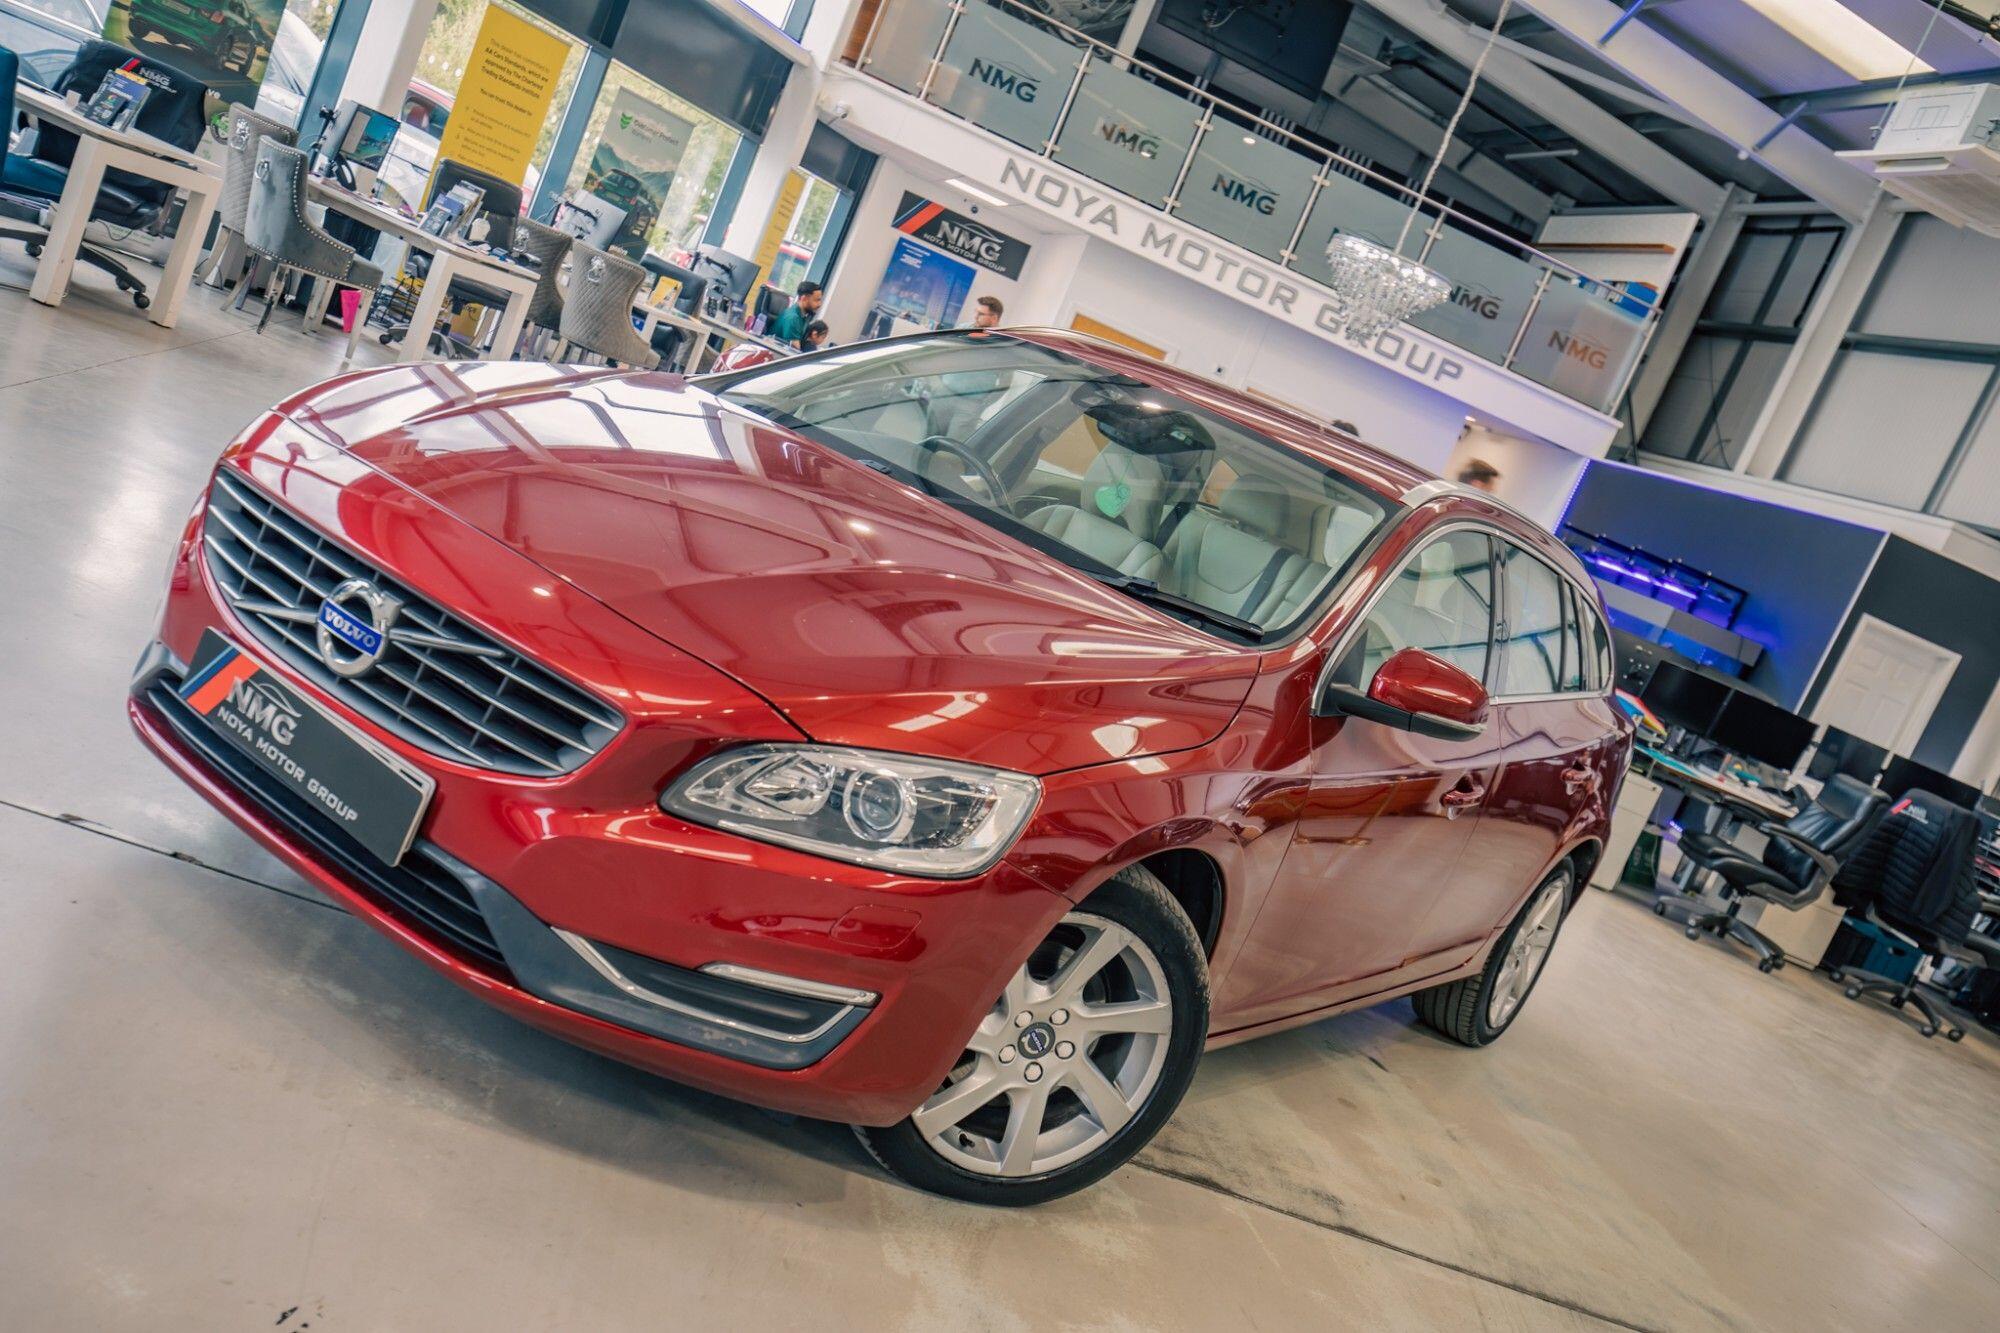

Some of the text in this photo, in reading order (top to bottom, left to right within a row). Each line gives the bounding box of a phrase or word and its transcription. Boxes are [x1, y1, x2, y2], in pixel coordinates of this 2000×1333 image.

[968, 57, 1037, 103] NMG
[1092, 117, 1159, 160] NMG
[1211, 173, 1277, 216] NMG
[936, 220, 1002, 262] NMG
[947, 244, 976, 261] MOTOR
[1000, 157, 1119, 235] NOYA
[1140, 222, 1299, 314] MOTOR
[1548, 329, 1607, 370] NMG
[323, 604, 377, 650] VOLVO
[226, 675, 299, 747] NMG
[217, 705, 359, 823] NOYA MOTOR GROUP
